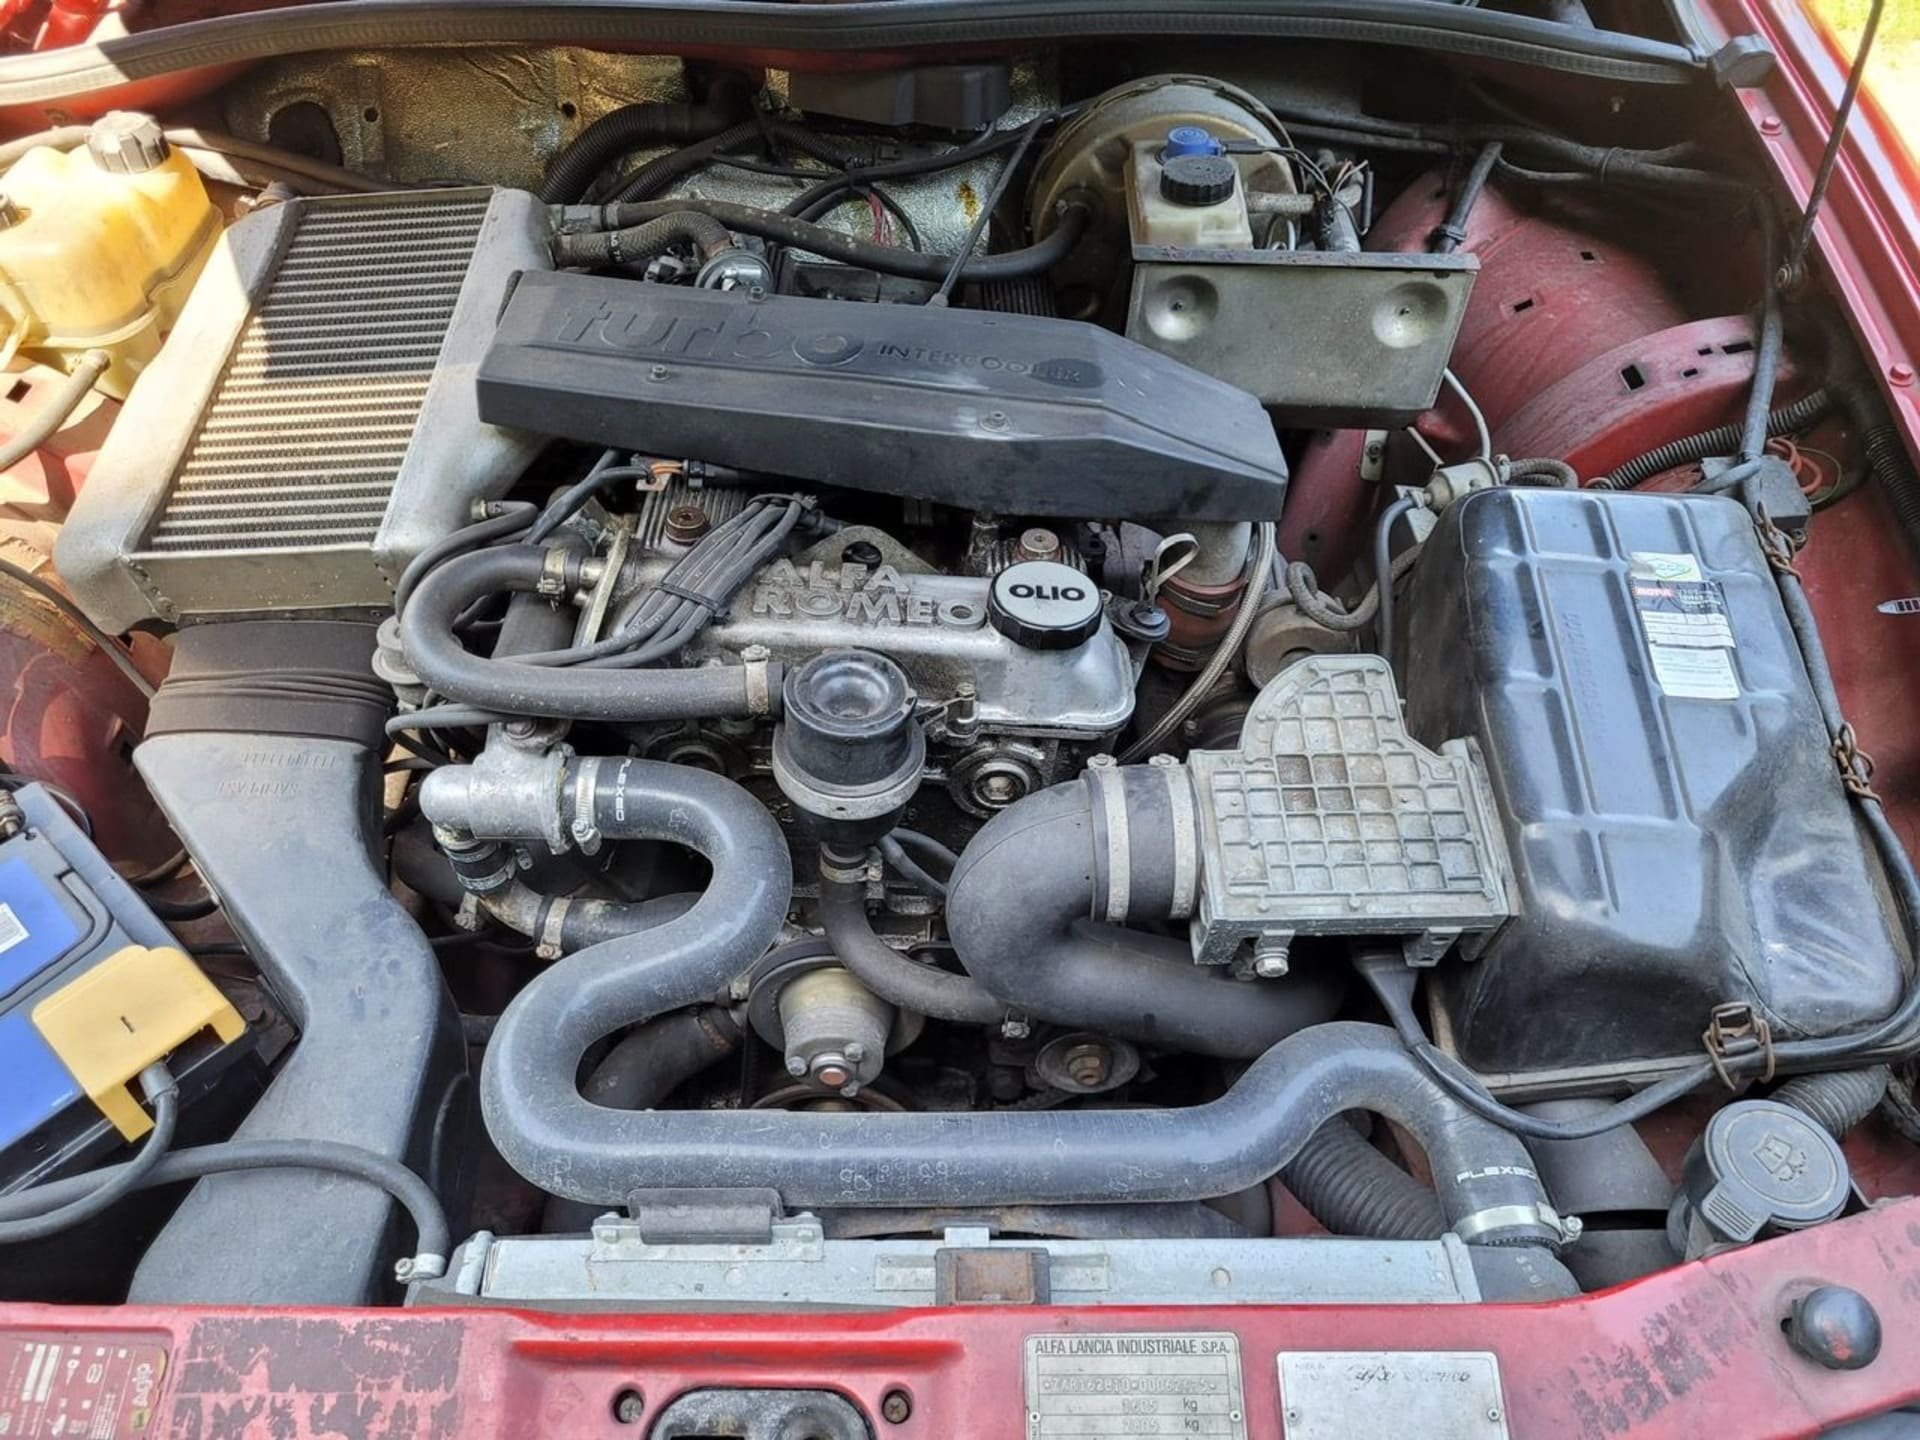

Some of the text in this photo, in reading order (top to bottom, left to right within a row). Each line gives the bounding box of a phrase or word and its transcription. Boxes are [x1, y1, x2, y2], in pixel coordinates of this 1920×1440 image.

[760, 558, 911, 594] ALFA
[1009, 584, 1086, 602] OLIO
[752, 588, 988, 632] ROMEO
[1035, 1340, 1066, 1354] ALFA
[1069, 1340, 1114, 1354] LANCIA
[1116, 1339, 1197, 1354] INDUSTRIALE
[1183, 1397, 1198, 1413] kg
[1185, 1417, 1200, 1433] kg
